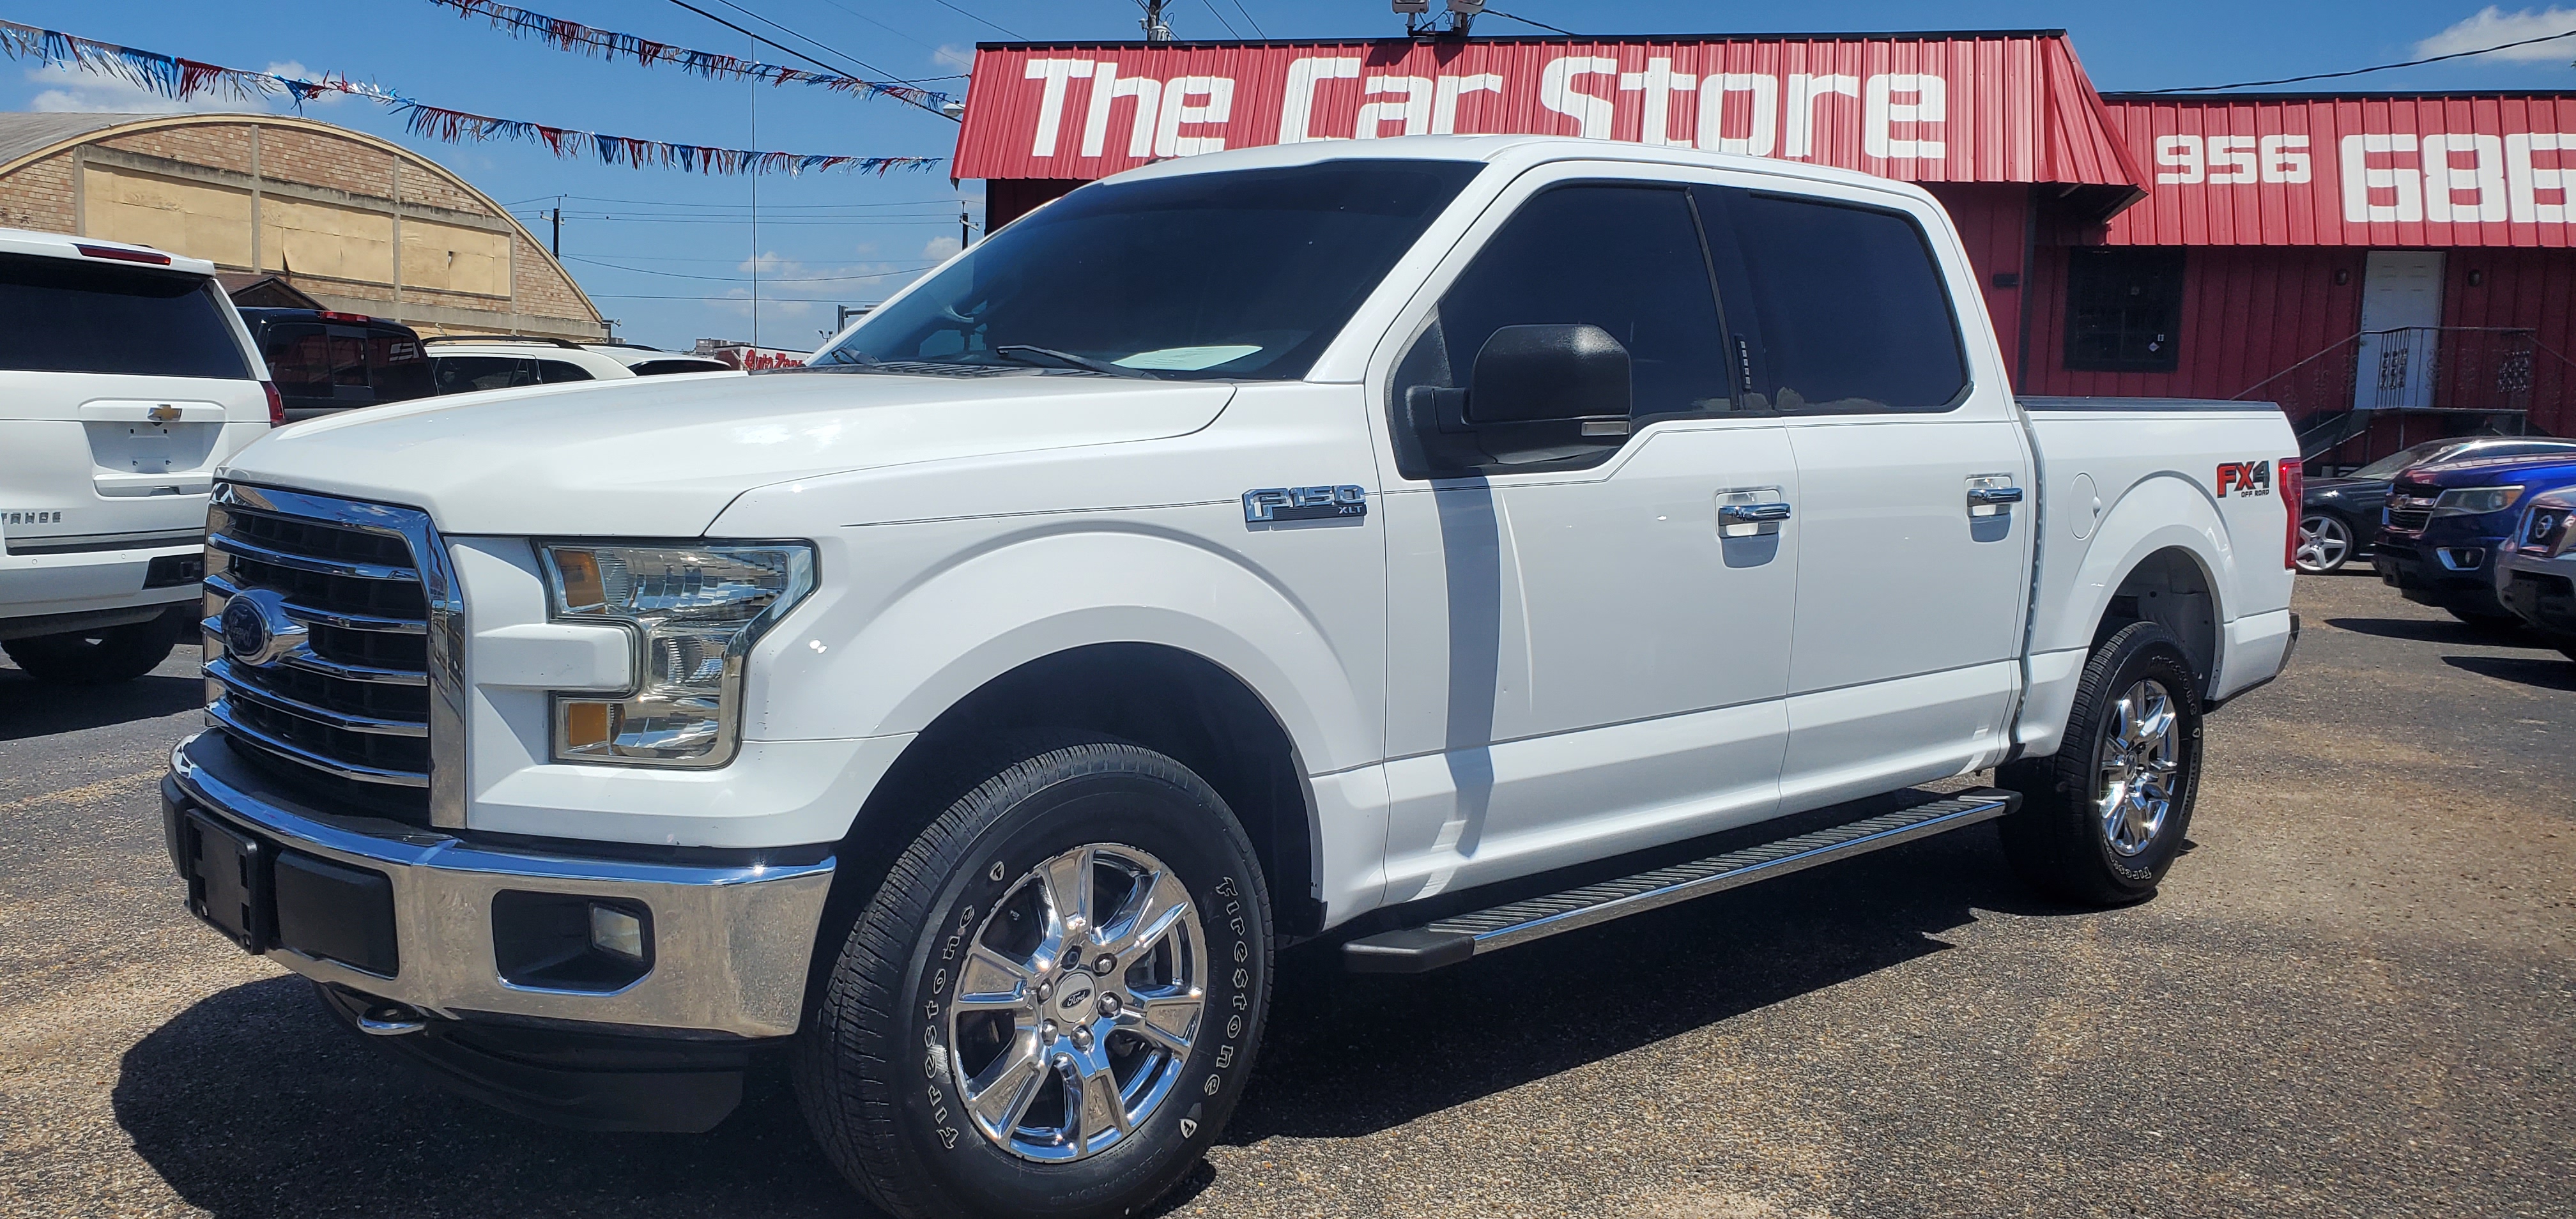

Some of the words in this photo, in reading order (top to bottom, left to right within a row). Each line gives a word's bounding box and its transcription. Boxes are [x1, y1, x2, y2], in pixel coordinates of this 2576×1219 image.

[1024, 58, 1235, 158] The
[1278, 56, 1503, 145] Car
[1540, 56, 1945, 159] Store
[2156, 134, 2312, 185] 956
[2342, 132, 2576, 223] 686
[1242, 484, 1367, 522] F150
[1338, 505, 1363, 514] XLT
[2216, 460, 2270, 498] FX4
[1066, 990, 1087, 1008] Ford
[1204, 876, 1249, 1096] Firestone
[924, 904, 976, 1149] Firestone
